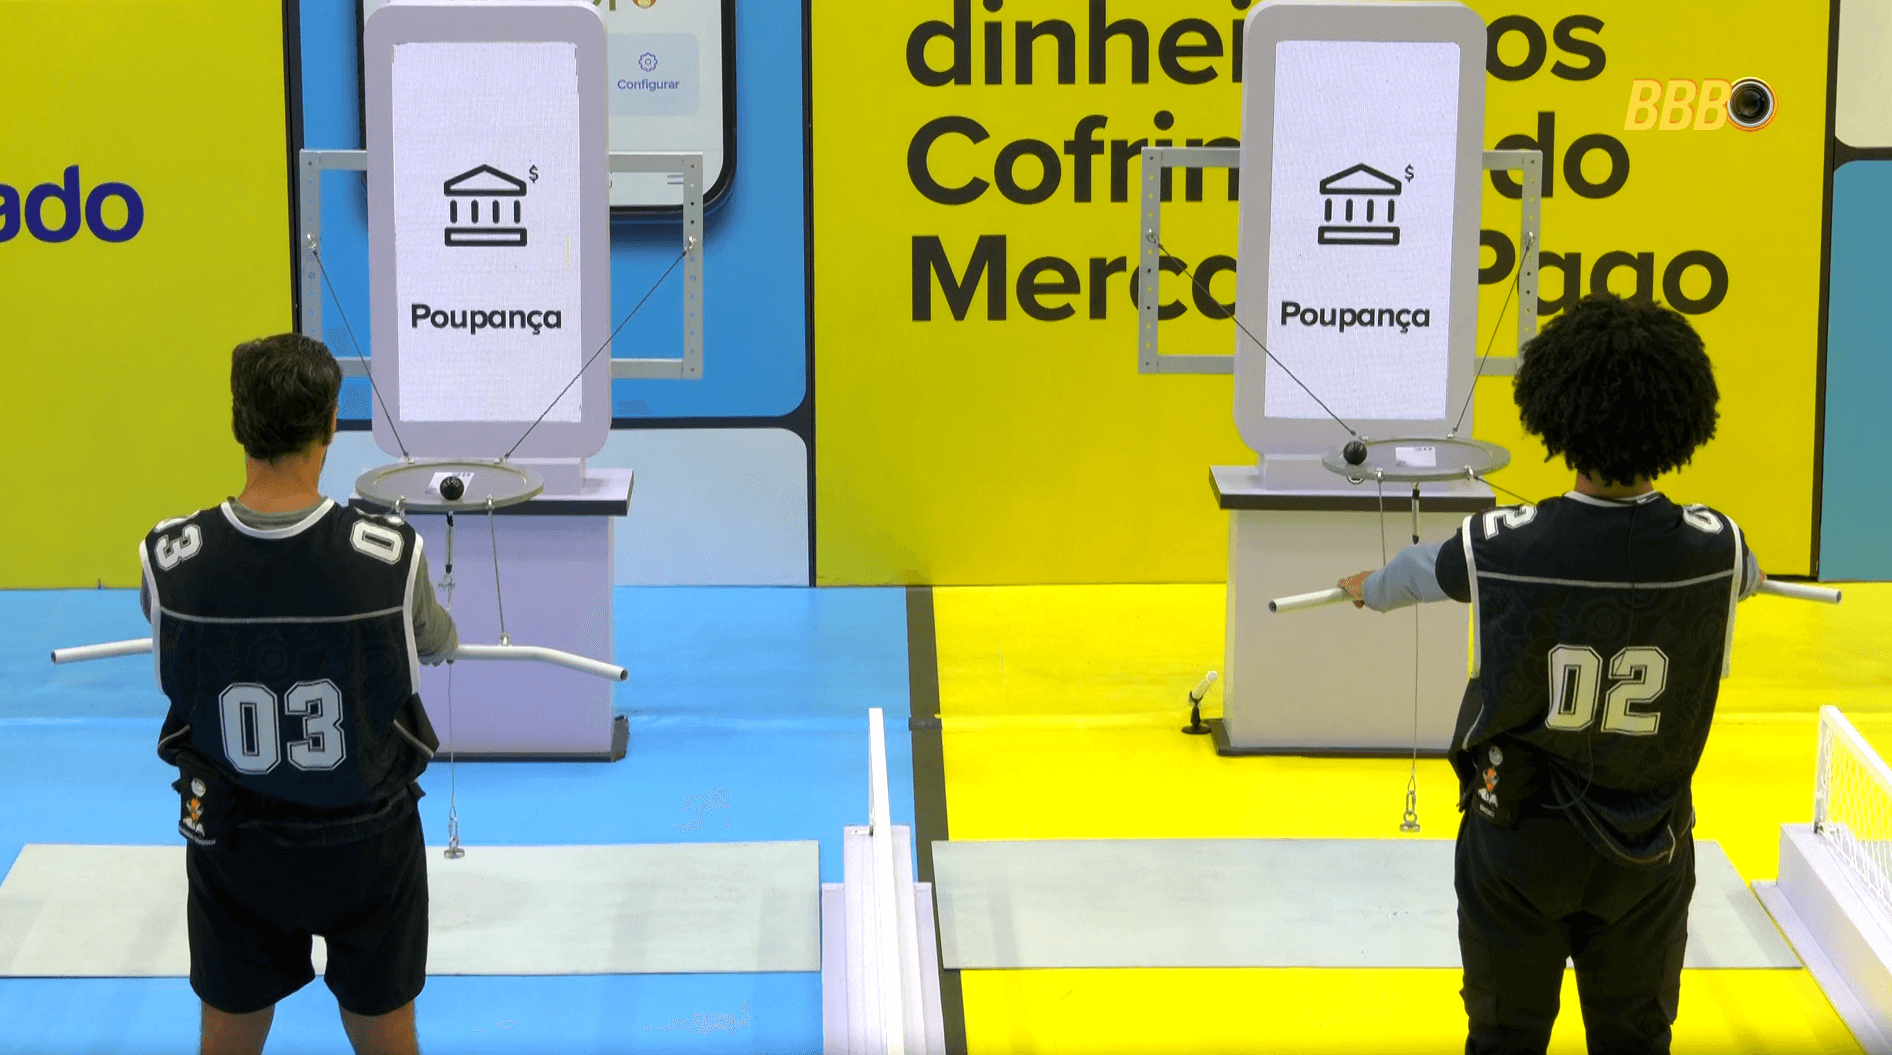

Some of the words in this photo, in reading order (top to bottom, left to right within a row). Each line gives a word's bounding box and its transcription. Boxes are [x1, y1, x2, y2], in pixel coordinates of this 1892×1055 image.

[617, 79, 680, 92] Configurar
[905, 0, 1250, 86] dinhei
[907, 110, 1240, 206] Cofrin
[411, 303, 562, 336] Poupança
[1281, 301, 1430, 333] Poupança
[218, 678, 346, 775] 03
[1544, 644, 1669, 735] 02
